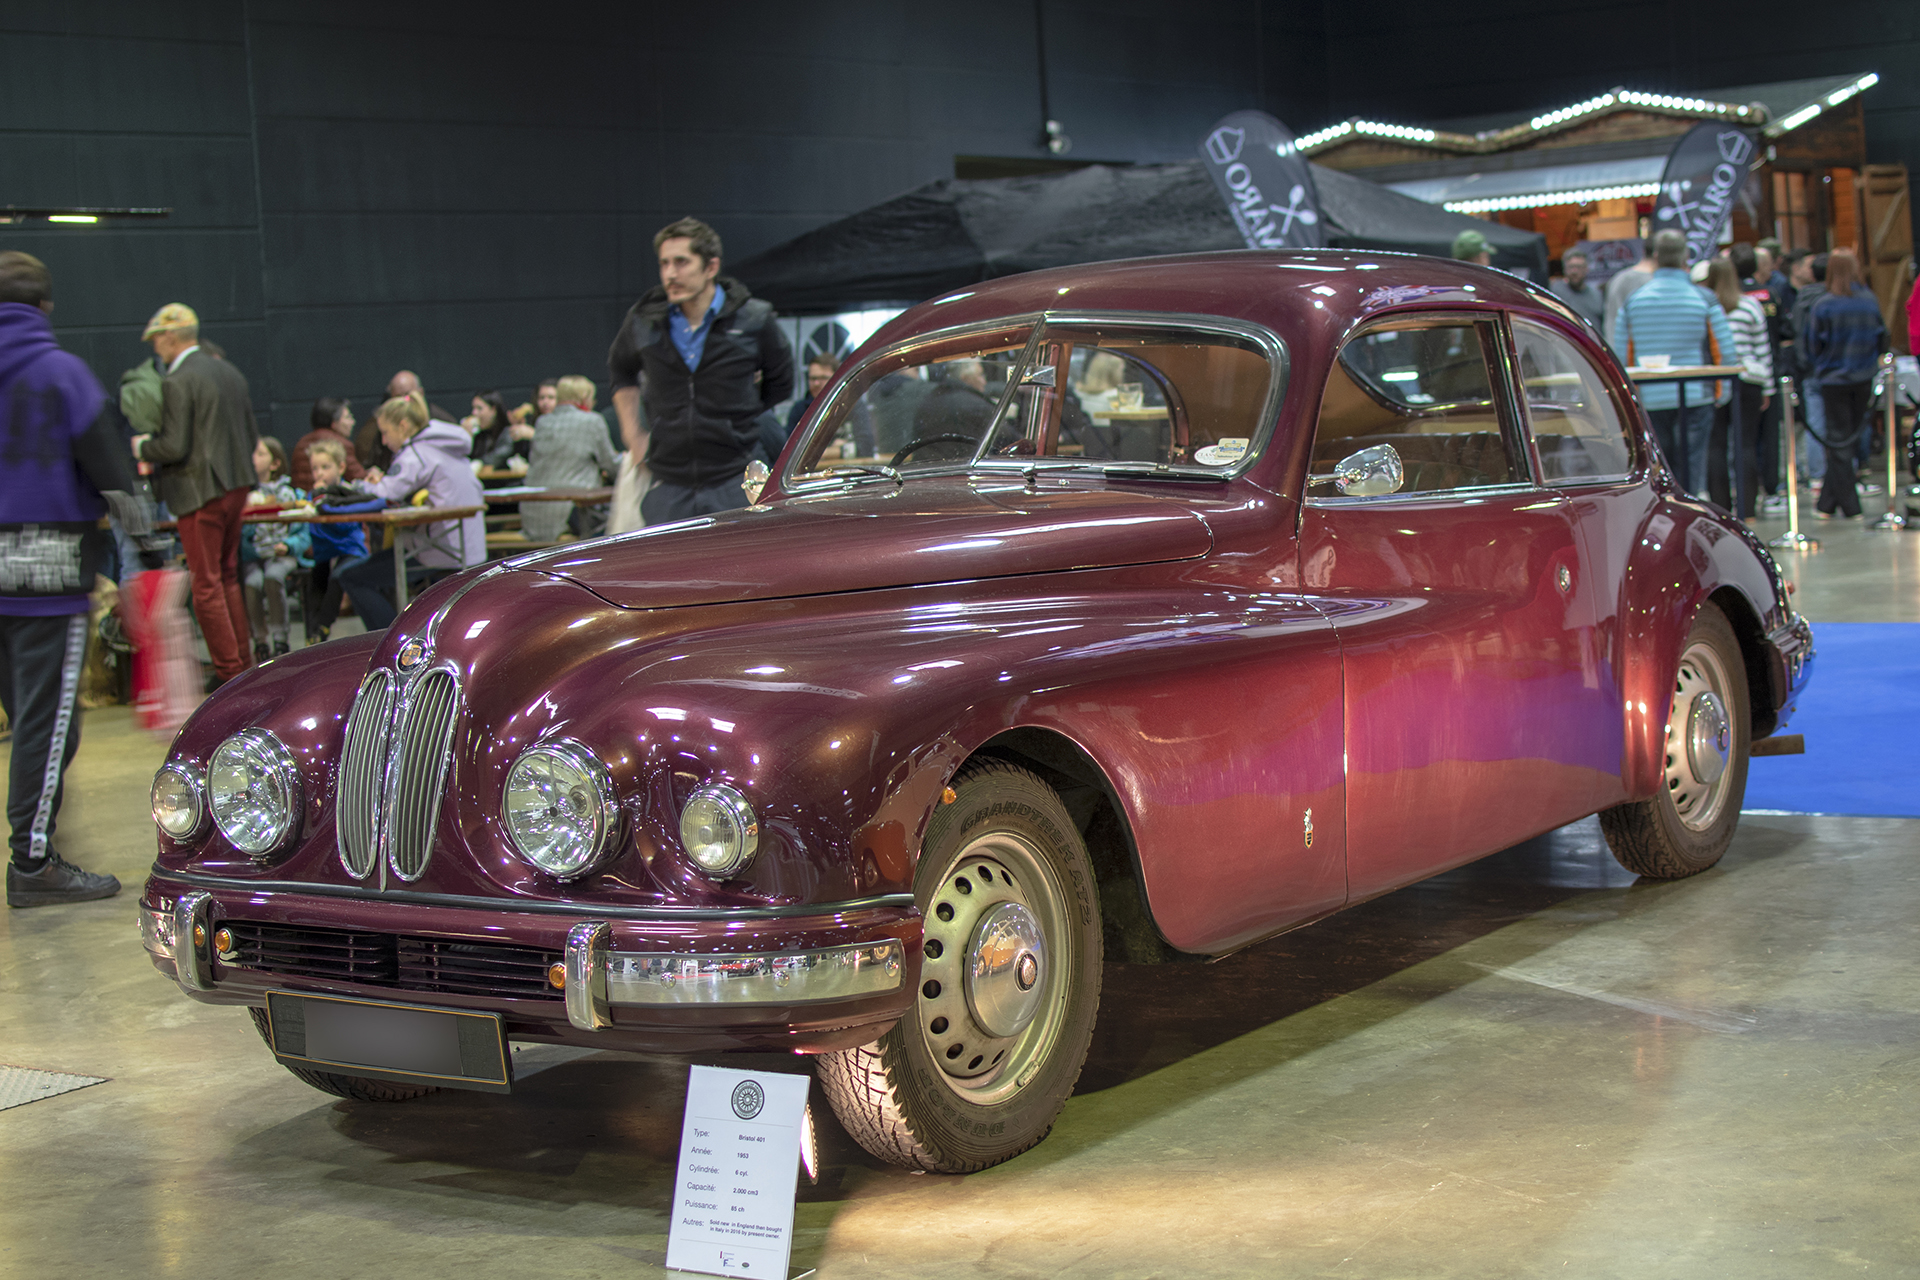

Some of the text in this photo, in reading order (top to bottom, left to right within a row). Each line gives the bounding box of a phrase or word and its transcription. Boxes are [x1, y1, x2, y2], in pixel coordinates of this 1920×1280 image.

[960, 800, 1075, 865] GRANDTREK
[694, 1128, 710, 1137] Type:
[738, 1134, 755, 1142] Bristol
[691, 1146, 713, 1155] Année:
[688, 1163, 720, 1174] Cylindrée:
[686, 1181, 716, 1192] Capacité:
[685, 1199, 718, 1210] Puissance:
[682, 1217, 704, 1227] Autres:
[766, 1225, 783, 1233] bought
